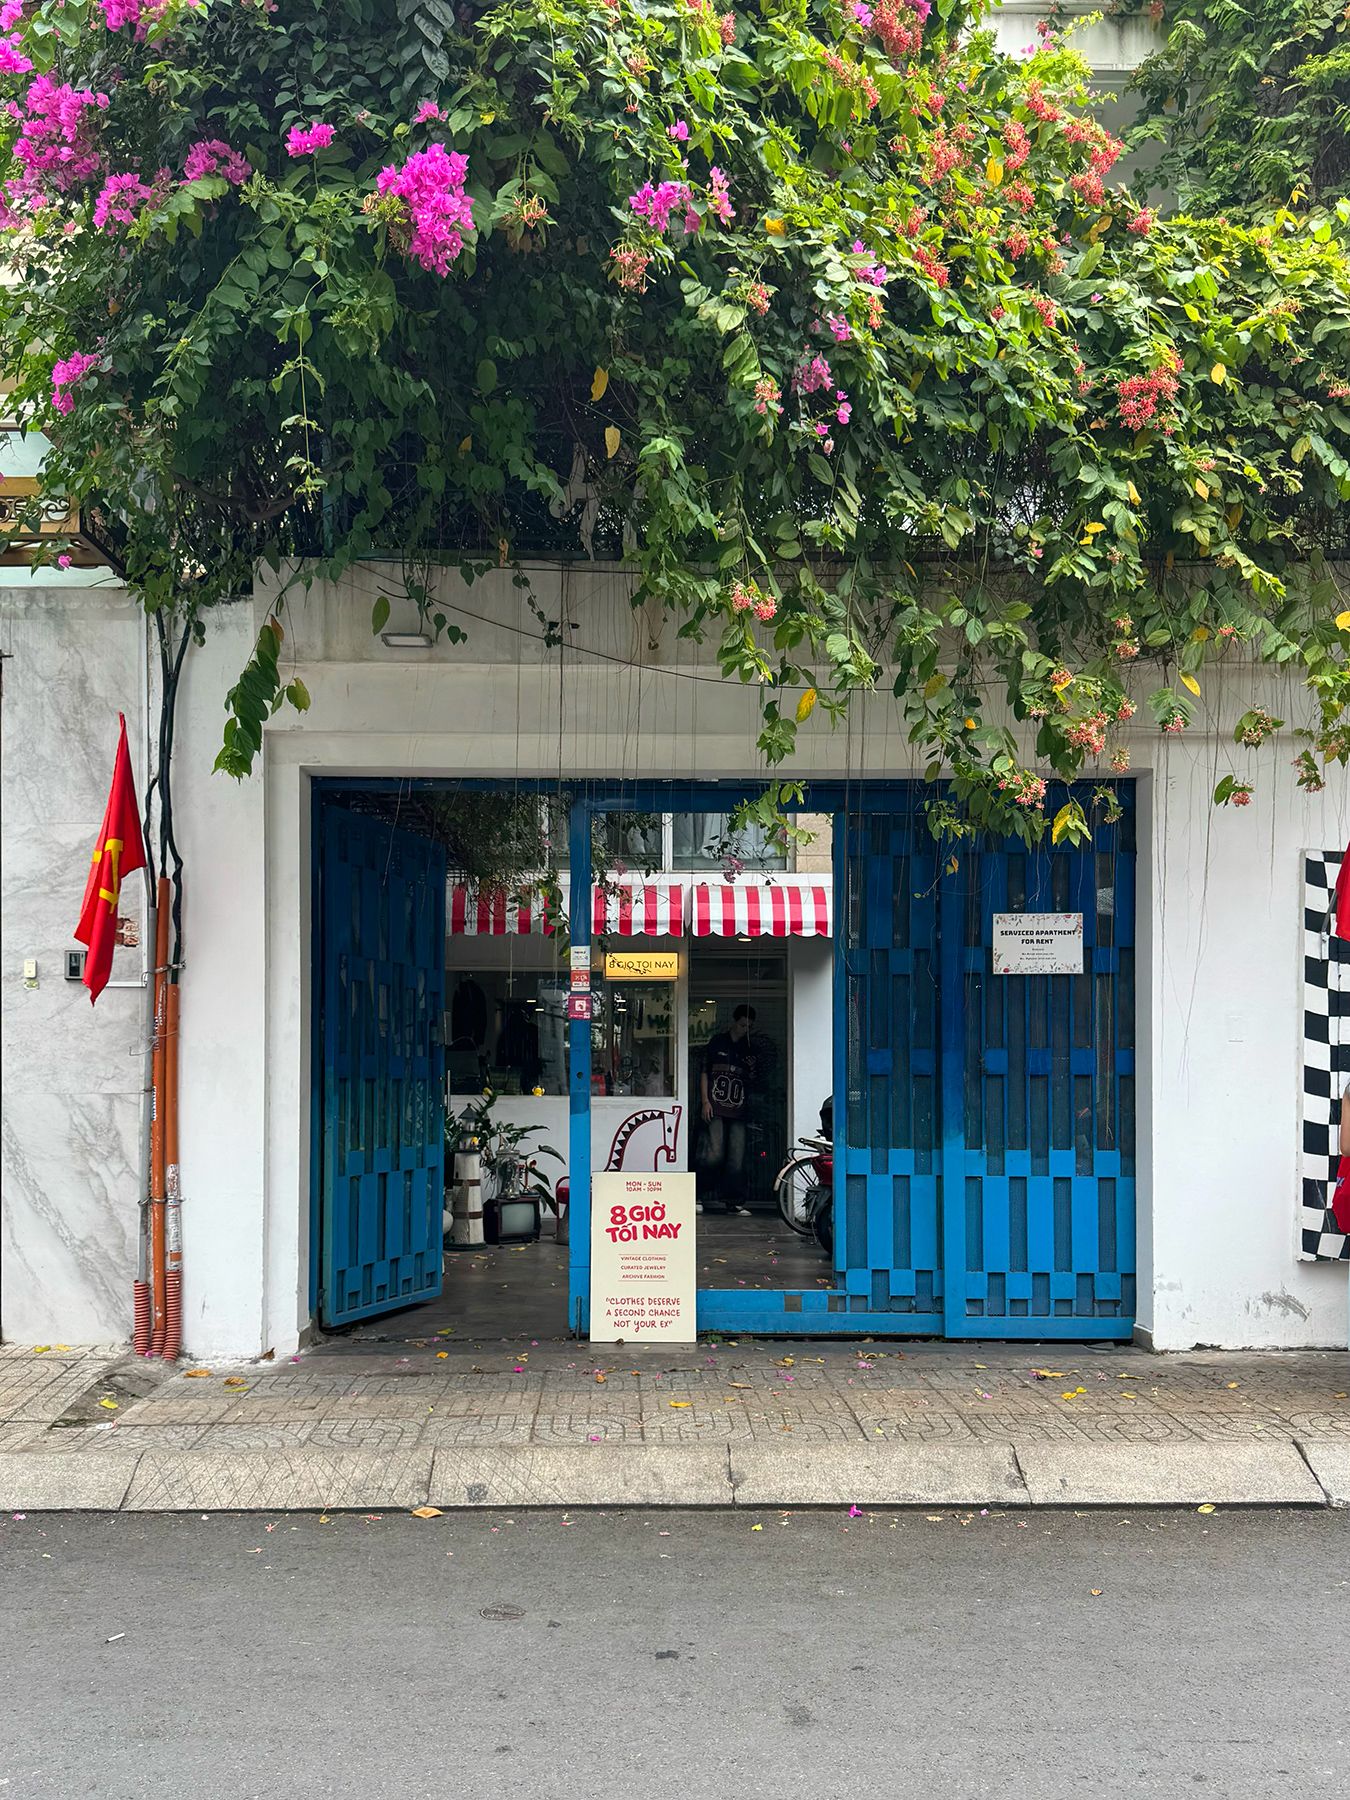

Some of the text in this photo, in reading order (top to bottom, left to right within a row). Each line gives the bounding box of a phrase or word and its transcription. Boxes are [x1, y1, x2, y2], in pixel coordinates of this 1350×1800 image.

[655, 960, 675, 969] NAY
[711, 1074, 745, 1106] 90
[610, 1200, 666, 1225] 8 GIỜ
[605, 1223, 682, 1243] TỐI NAY
[648, 1297, 681, 1306] DESERVE
[614, 1308, 646, 1317] SECOND
[648, 1308, 680, 1317] CHANCE
[613, 1320, 631, 1328] NOT
